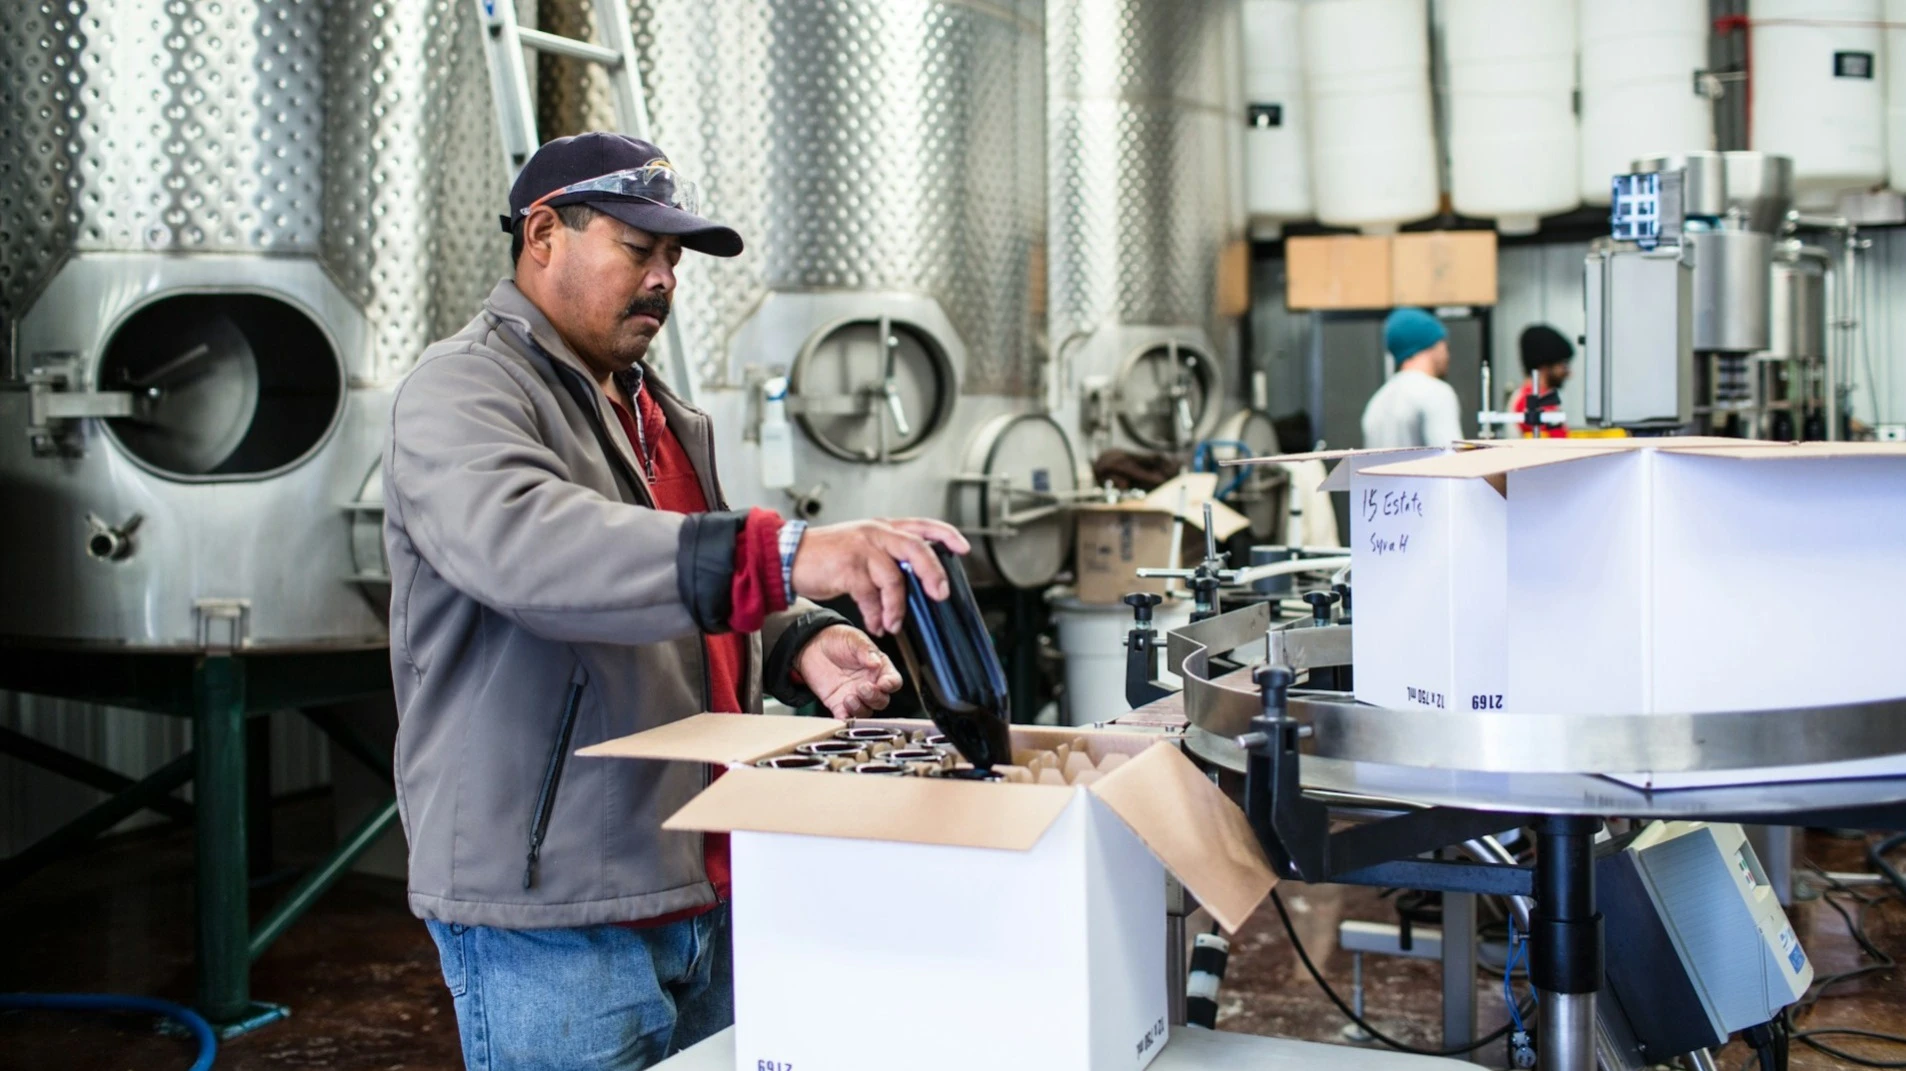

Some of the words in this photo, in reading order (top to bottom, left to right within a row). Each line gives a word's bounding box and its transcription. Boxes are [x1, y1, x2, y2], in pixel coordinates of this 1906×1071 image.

[1363, 488, 1377, 522] 15
[1383, 491, 1423, 517] Estate
[1418, 689, 1430, 706] 750
[1436, 693, 1445, 709] 12
[1471, 694, 1503, 710] 2169
